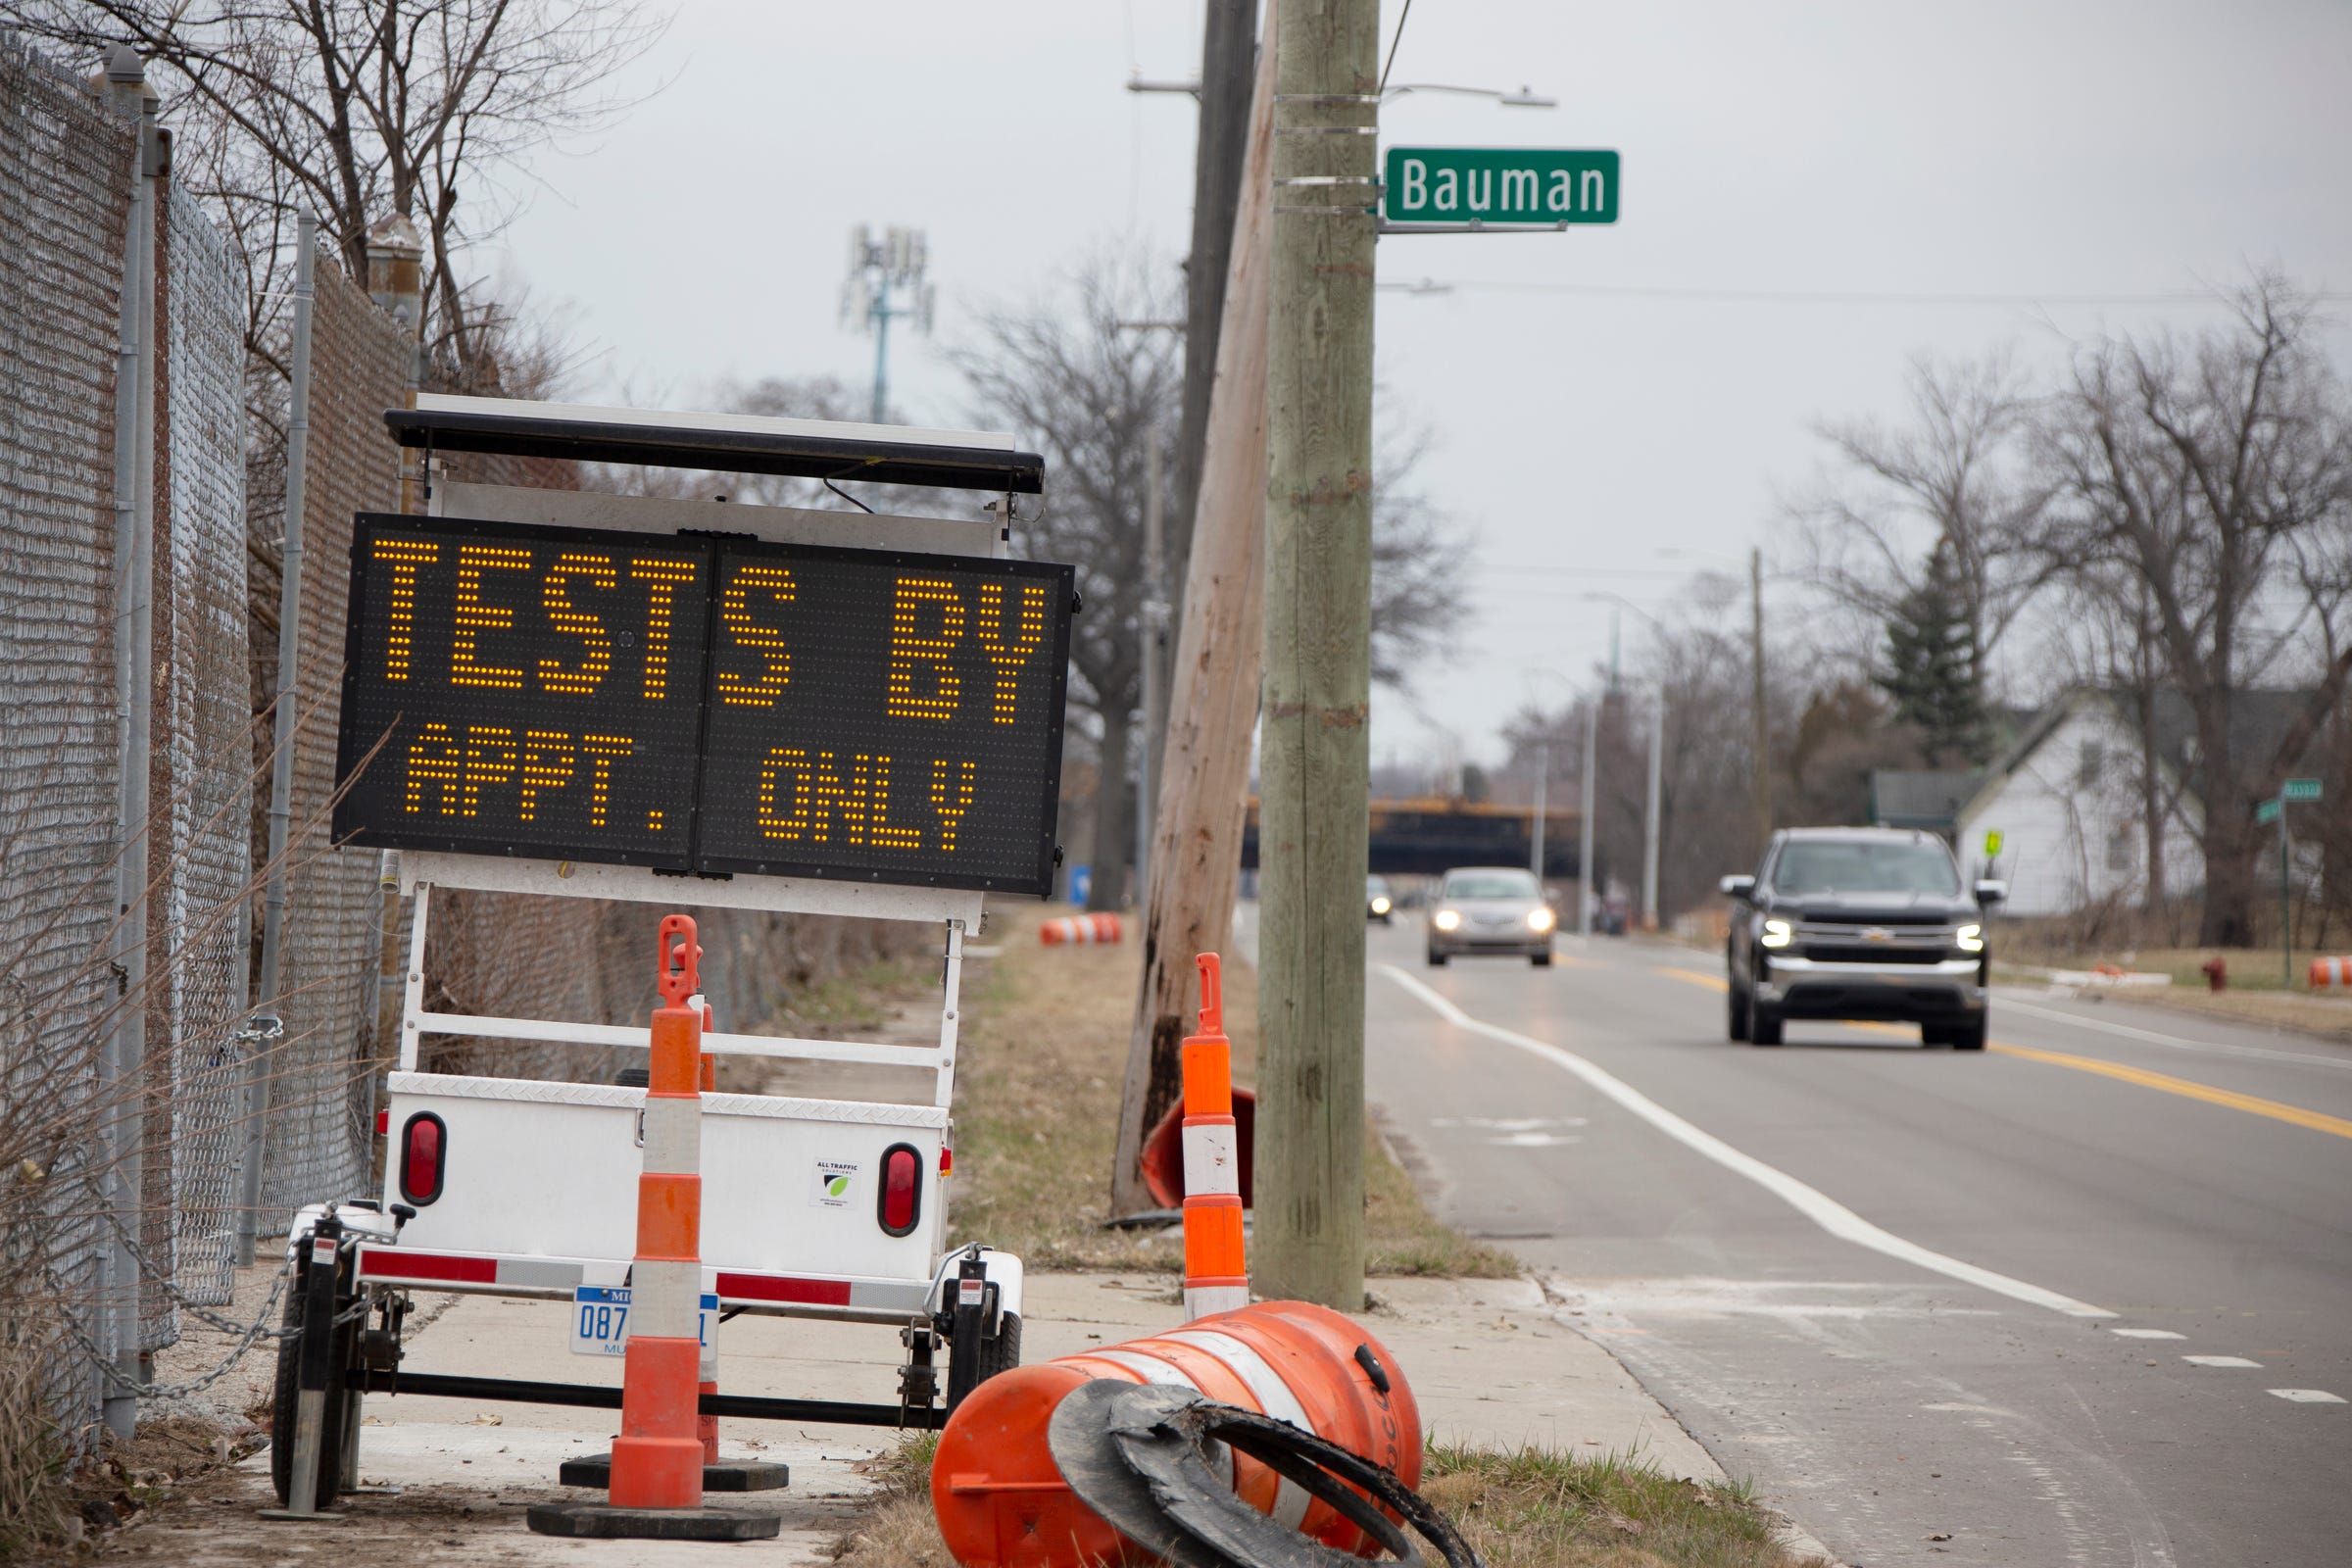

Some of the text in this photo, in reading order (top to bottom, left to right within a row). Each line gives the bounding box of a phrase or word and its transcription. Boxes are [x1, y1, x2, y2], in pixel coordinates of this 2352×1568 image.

[1402, 159, 1604, 213] Bauman
[374, 541, 1044, 723] TESTS BY
[407, 724, 974, 850] APPT. ONLY
